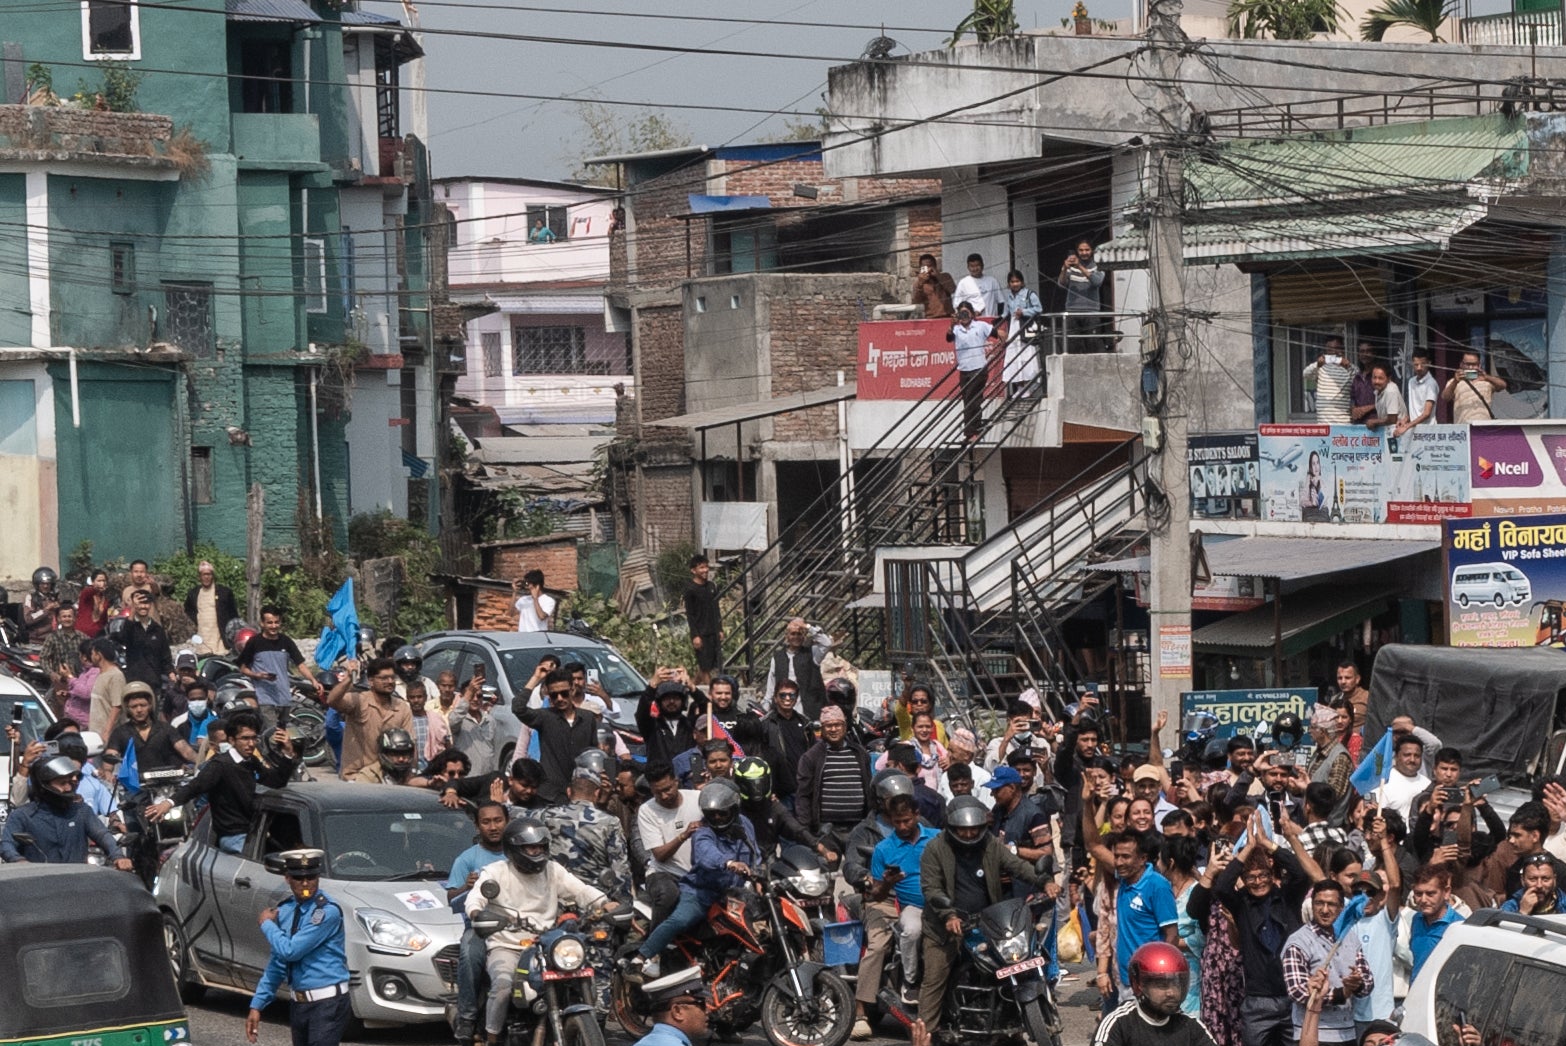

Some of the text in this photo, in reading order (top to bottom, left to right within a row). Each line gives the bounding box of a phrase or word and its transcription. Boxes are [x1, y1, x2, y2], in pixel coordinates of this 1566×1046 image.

[931, 350, 955, 365] move
[1227, 445, 1251, 459] SALOON
[1495, 462, 1529, 475] Ncell
[1453, 522, 1491, 551] महाँ
[1502, 550, 1519, 560] VIP
[1520, 549, 1542, 560] Sofa
